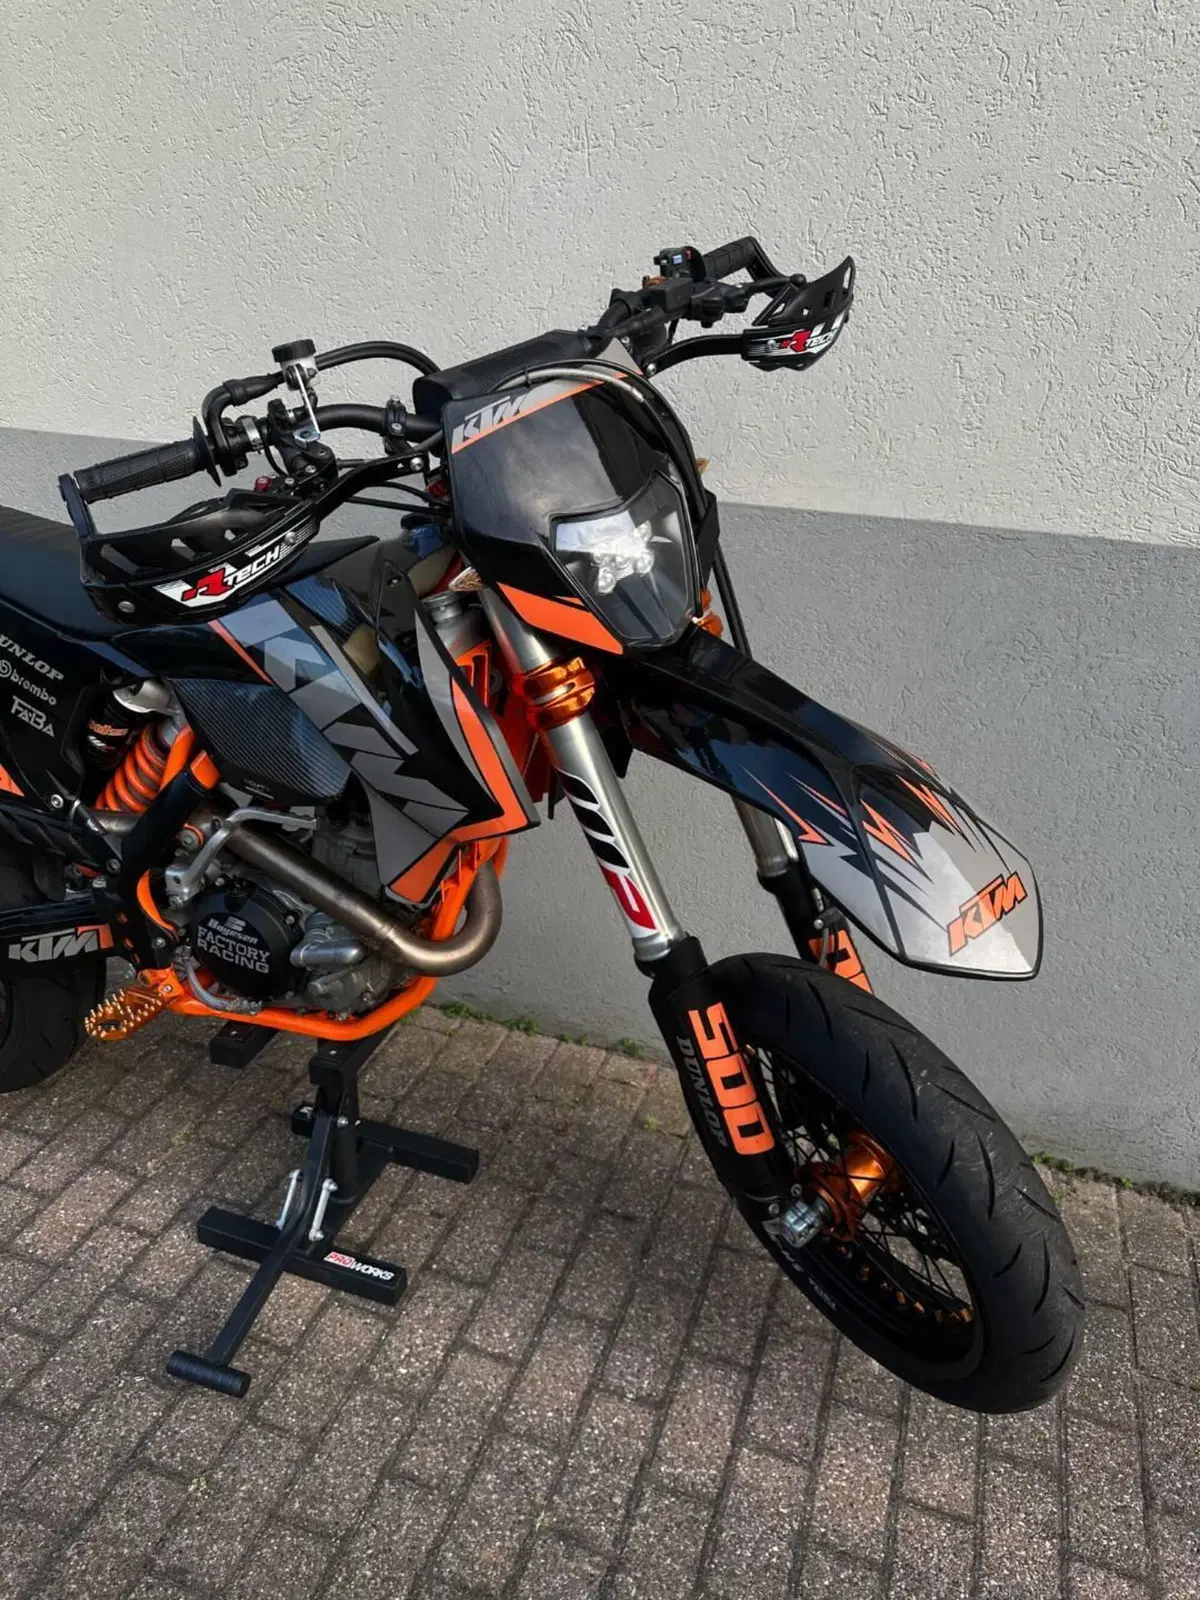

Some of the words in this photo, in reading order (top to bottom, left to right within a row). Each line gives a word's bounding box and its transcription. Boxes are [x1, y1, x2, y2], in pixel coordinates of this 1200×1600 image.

[0, 634, 64, 680] UNLOP
[11, 669, 57, 705] brembo
[947, 871, 1028, 956] KTM
[8, 923, 114, 962] KTM
[197, 925, 270, 962] FACTORY
[197, 938, 270, 974] RACING
[676, 1034, 730, 1148] DUNLOP
[688, 1002, 775, 1156] 500
